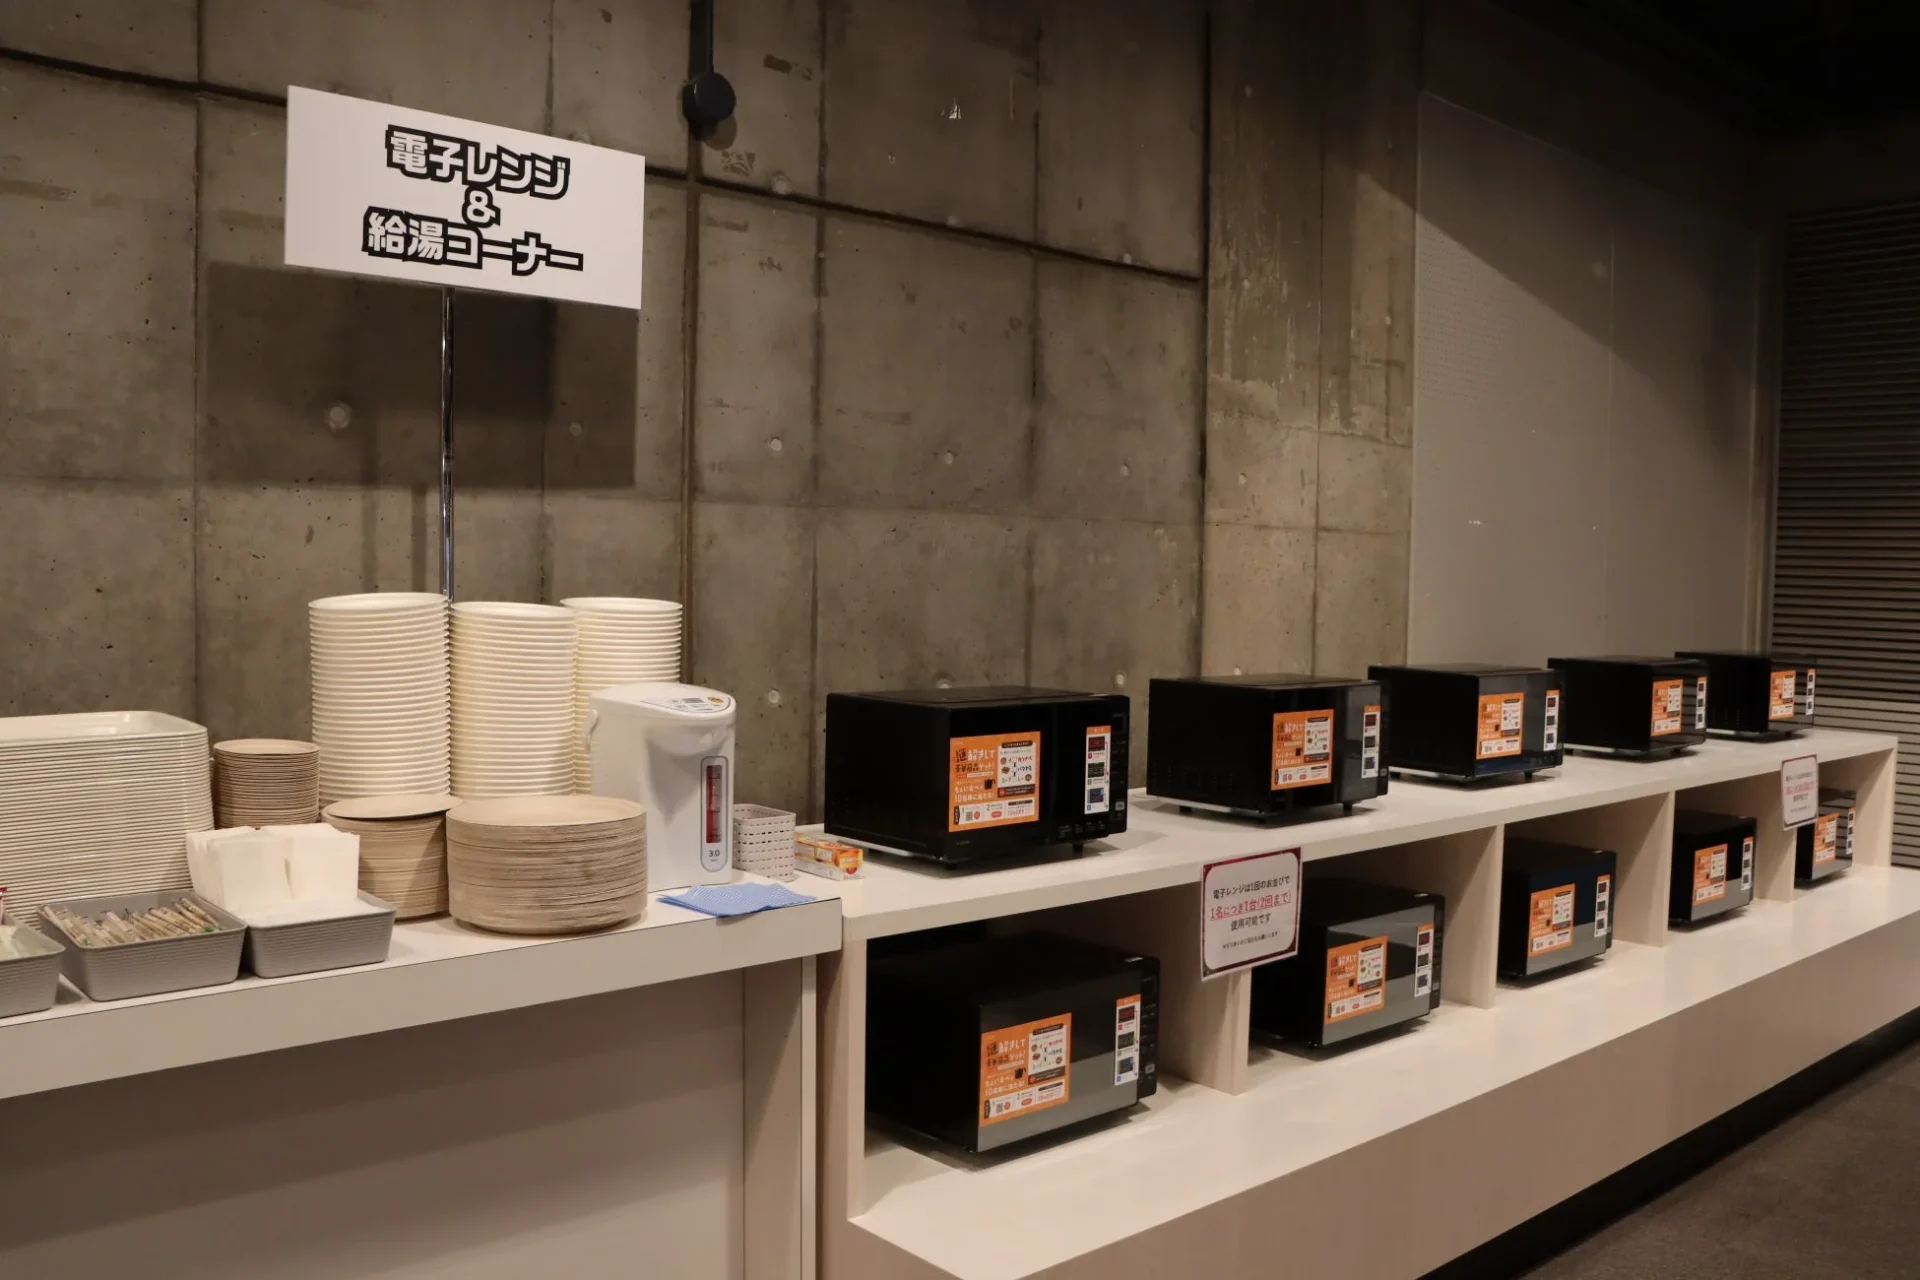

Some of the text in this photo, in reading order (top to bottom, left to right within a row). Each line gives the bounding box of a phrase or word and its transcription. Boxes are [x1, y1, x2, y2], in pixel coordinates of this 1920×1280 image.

[385, 124, 570, 200] 電子レンジ
[462, 186, 501, 228] &
[362, 206, 583, 276] 給湯コーナー
[1230, 912, 1272, 931] 使用可能です
